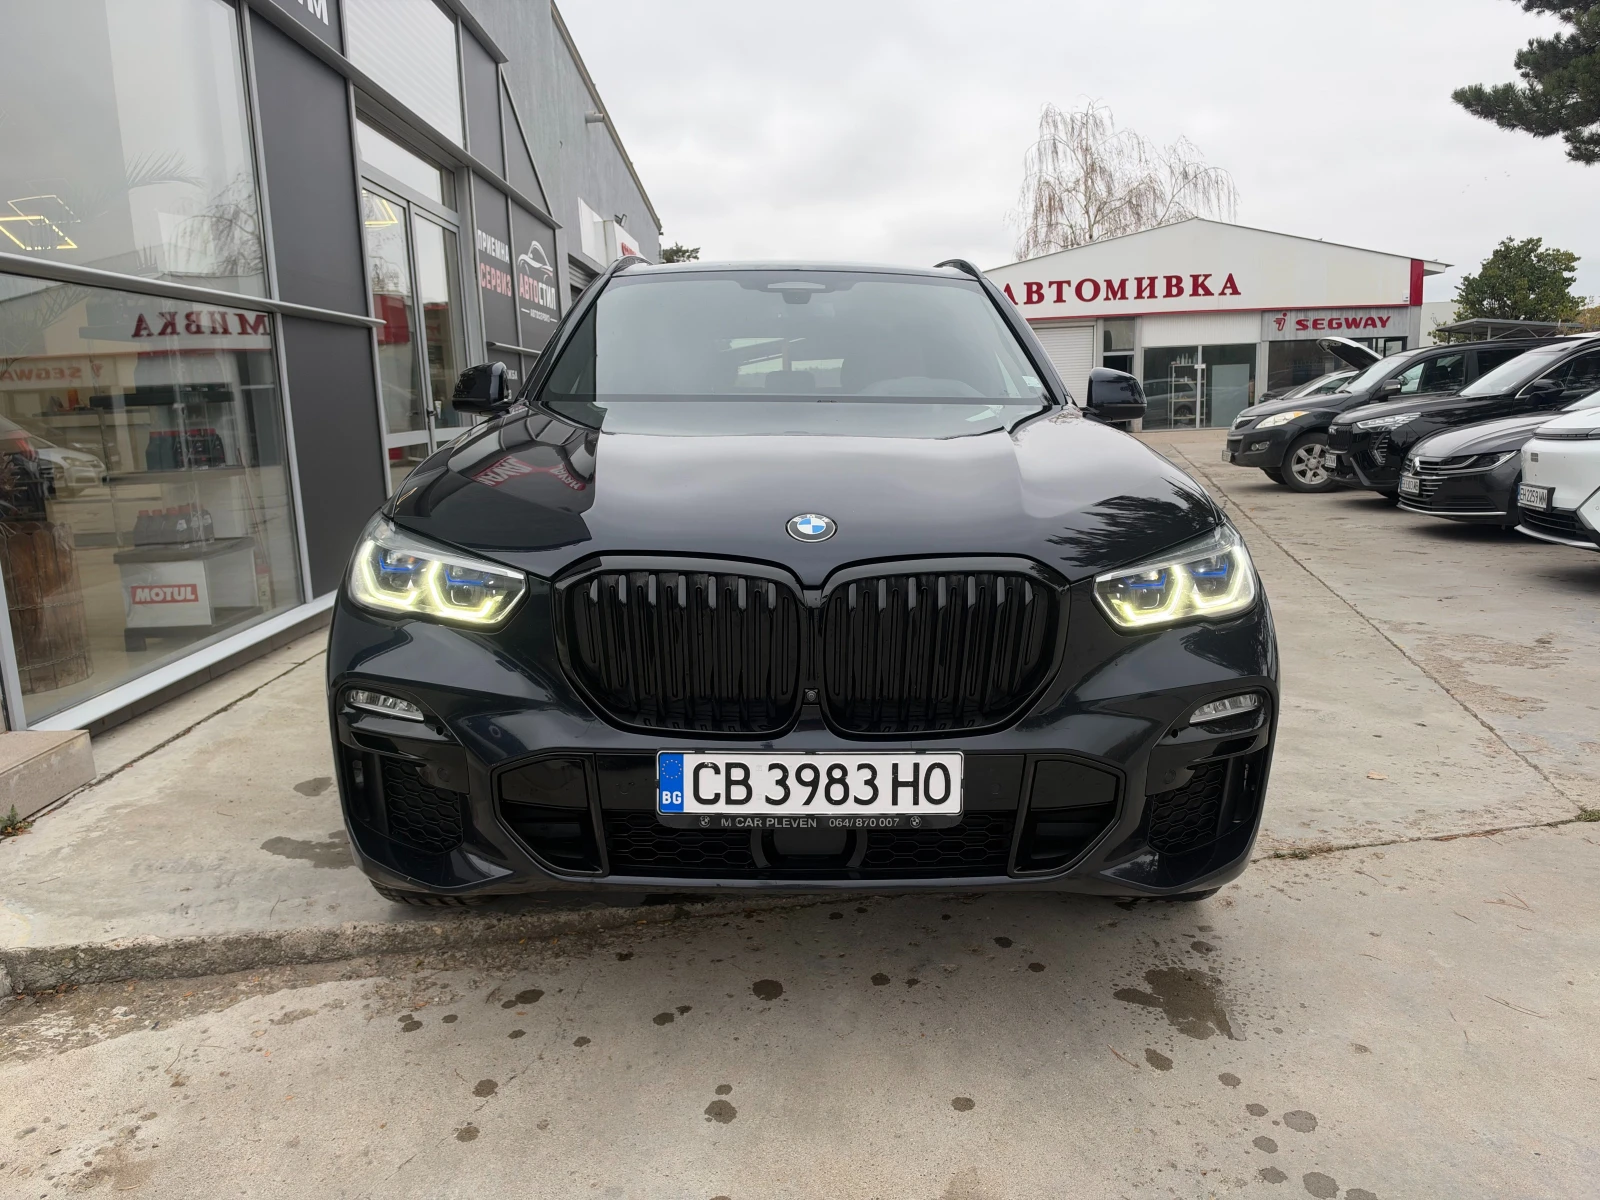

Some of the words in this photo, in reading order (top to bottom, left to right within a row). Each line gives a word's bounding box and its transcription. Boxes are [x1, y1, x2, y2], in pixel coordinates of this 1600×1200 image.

[477, 229, 510, 264] ПРИЕМНА
[480, 262, 512, 298] СЕРВИЗ
[519, 273, 557, 311] АВТОСТИЛ
[1003, 272, 1242, 306] АВТОМИВКА
[1295, 315, 1392, 331] SEGWAY
[1526, 488, 1539, 504] 2259
[134, 586, 196, 602] MOTUL
[692, 761, 753, 806] CB
[764, 761, 880, 806] 3983
[662, 791, 682, 805] BG
[721, 818, 732, 827] M
[735, 817, 762, 828] CAR
[766, 818, 817, 828] PLEVEN
[829, 818, 854, 828] 064/
[855, 818, 877, 827] 870
[878, 818, 900, 827] 007
